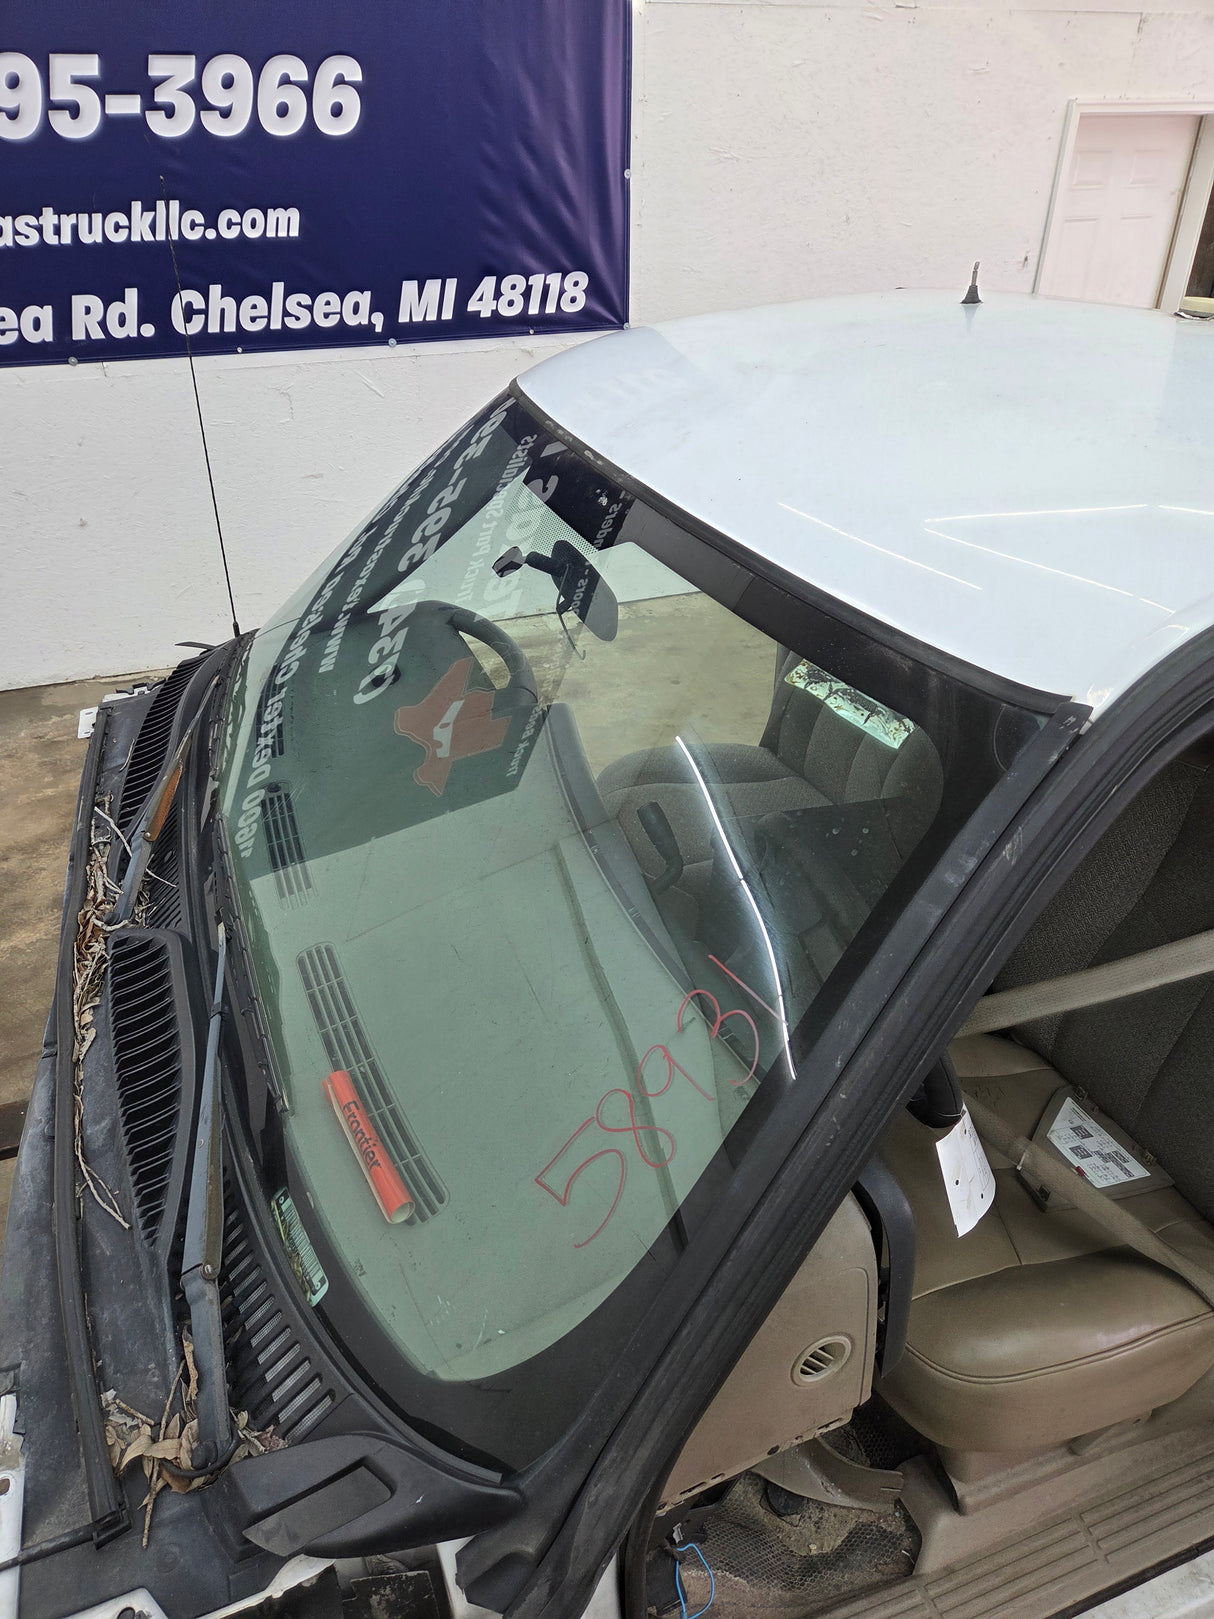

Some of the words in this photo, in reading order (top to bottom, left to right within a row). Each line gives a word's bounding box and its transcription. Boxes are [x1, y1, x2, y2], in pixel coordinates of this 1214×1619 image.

[0, 52, 362, 140] 95-3966
[71, 288, 156, 341] Rd.
[171, 281, 384, 335] Chelsea,
[398, 278, 457, 323] MI
[467, 271, 589, 318] 48118
[343, 1100, 382, 1171] Frontier
